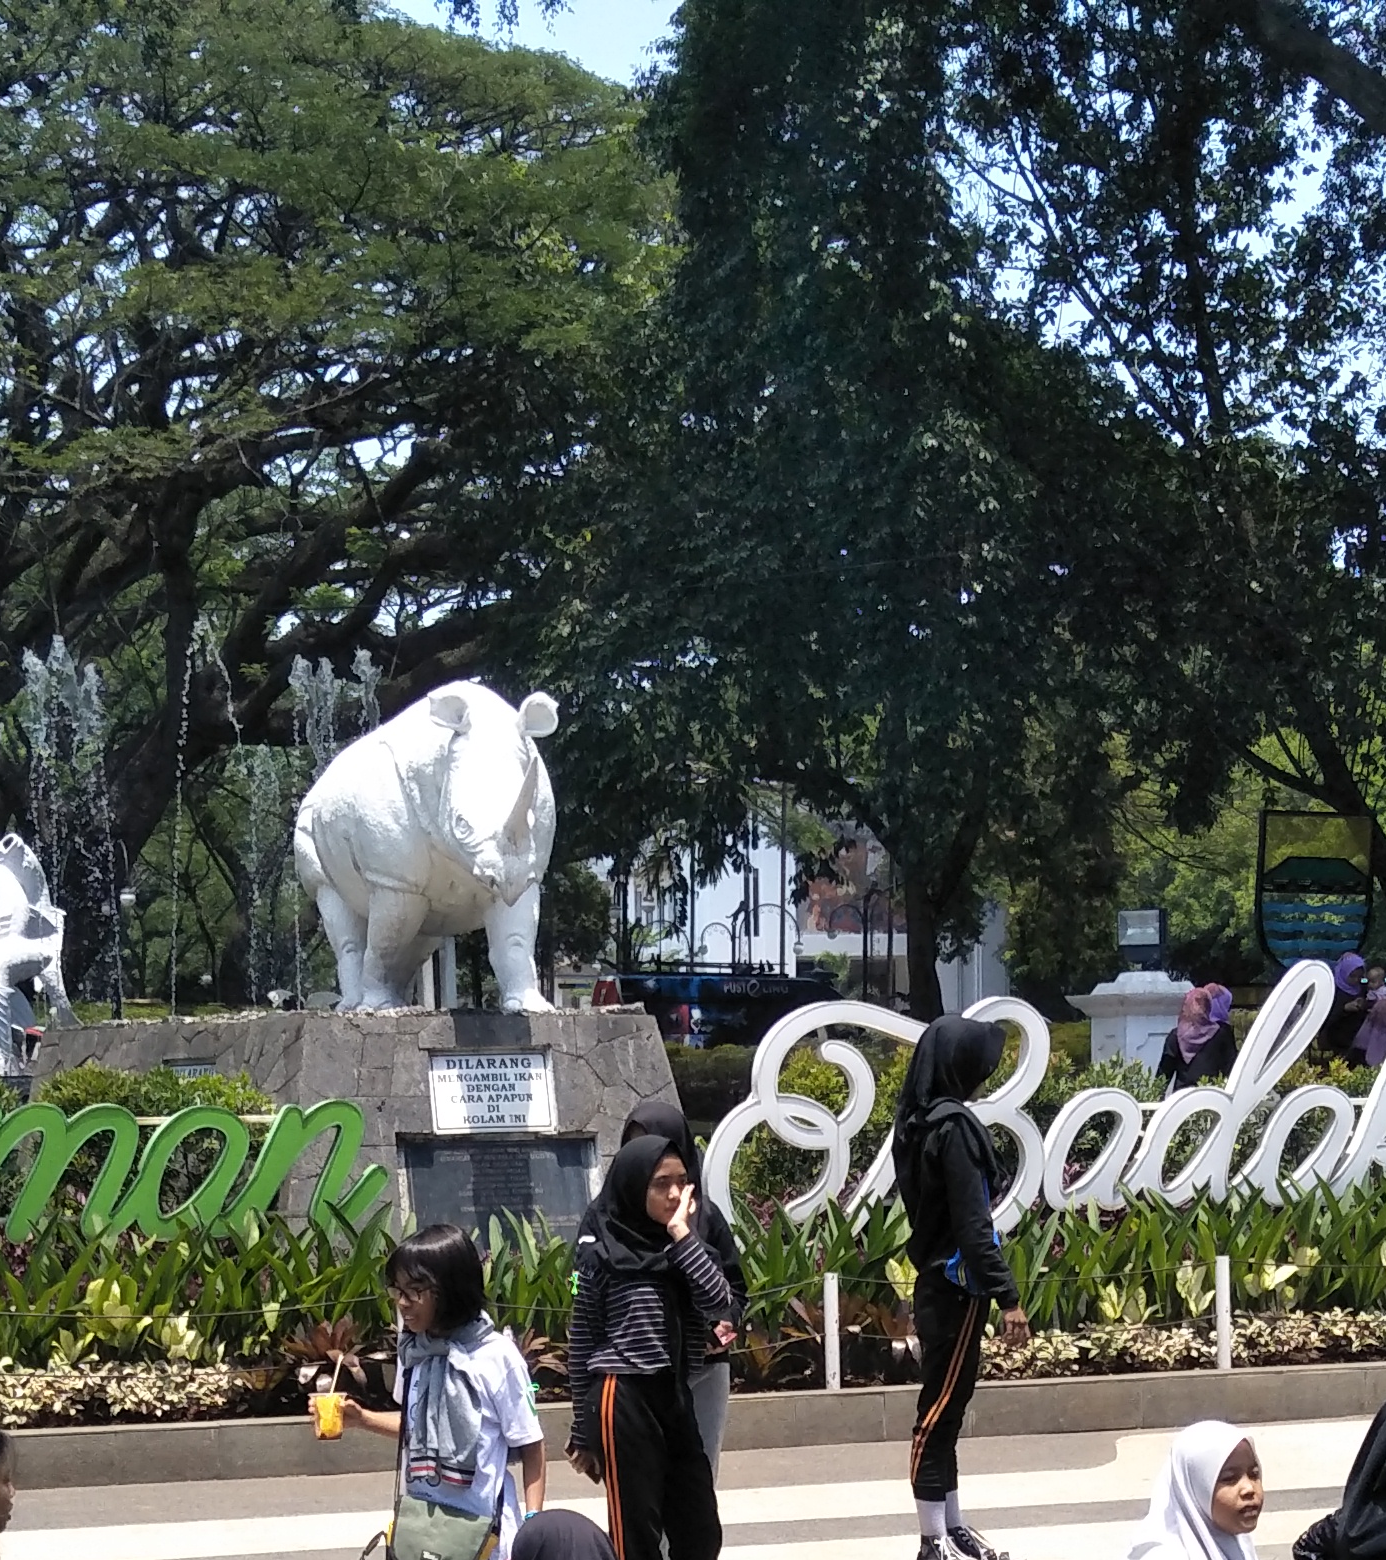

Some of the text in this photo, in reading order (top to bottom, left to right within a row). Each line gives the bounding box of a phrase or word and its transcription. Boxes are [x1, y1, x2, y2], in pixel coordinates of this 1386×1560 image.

[446, 1057, 532, 1070] DILARANG
[437, 1072, 542, 1083] MENGAMBIL IKAN
[466, 1083, 516, 1093] DENGAN
[451, 1093, 533, 1104] CARA APAPUN
[487, 1104, 501, 1113] DI
[463, 1114, 527, 1125] KOLAM INI
